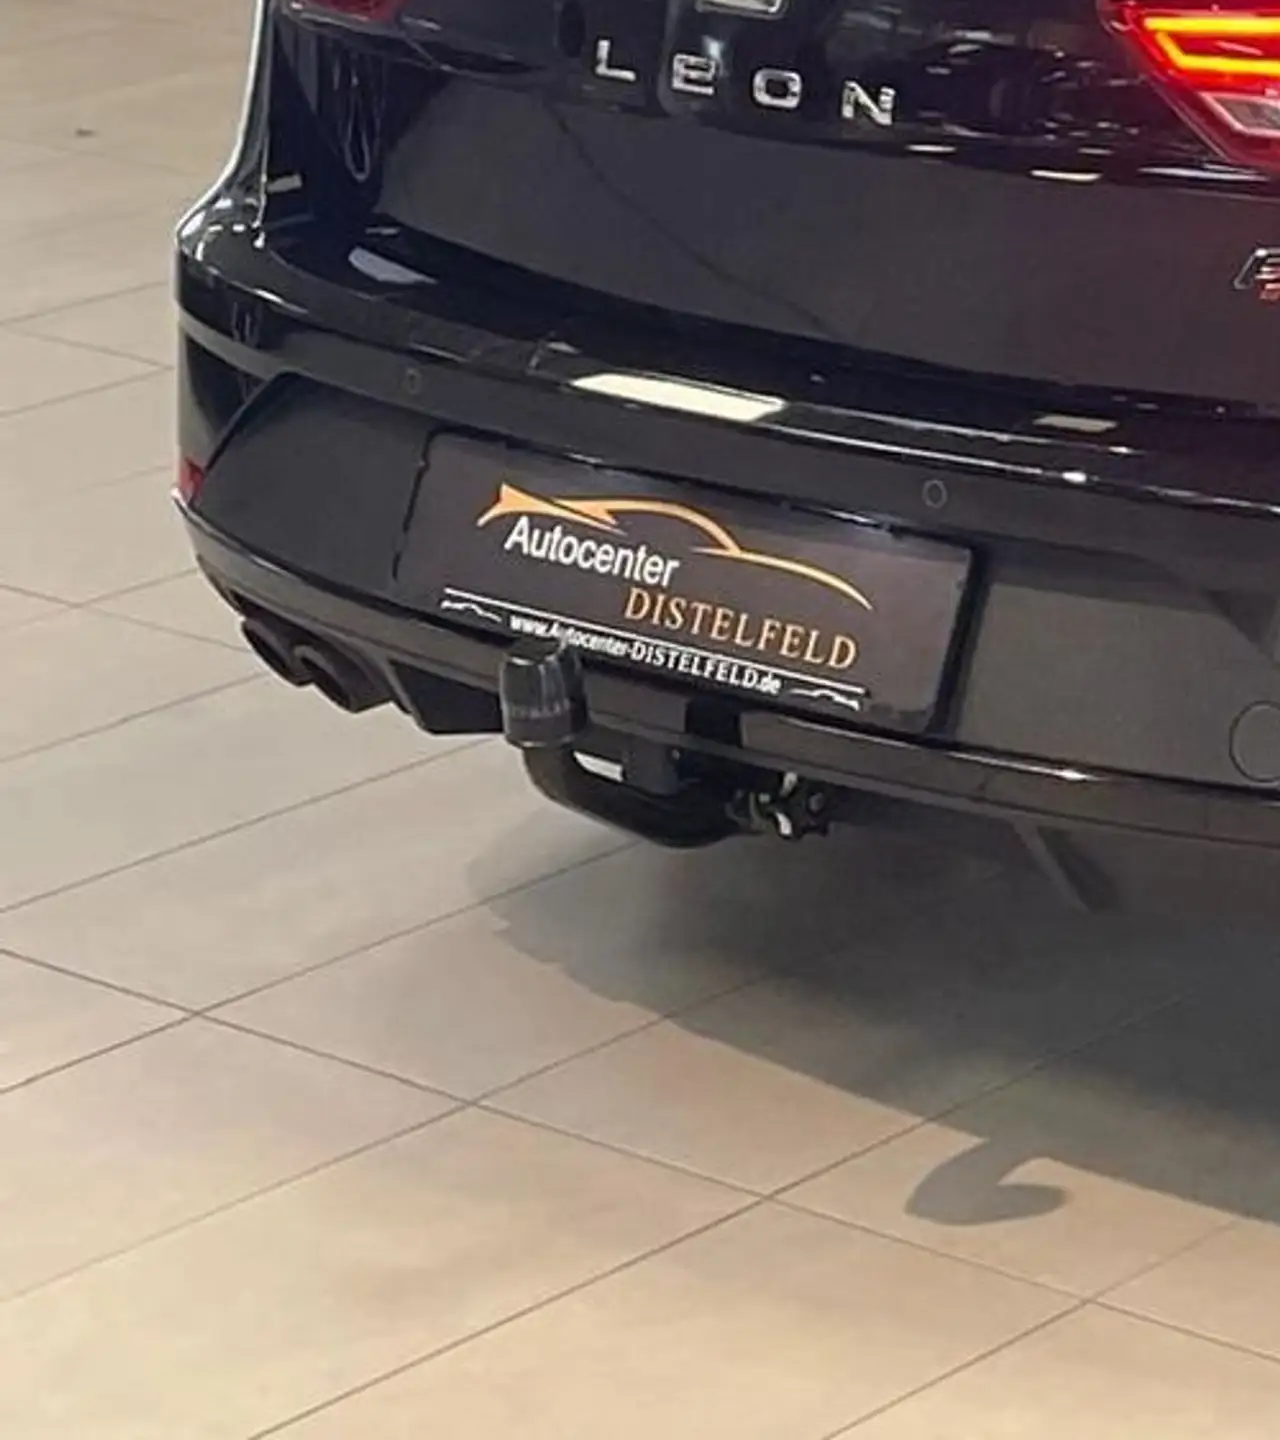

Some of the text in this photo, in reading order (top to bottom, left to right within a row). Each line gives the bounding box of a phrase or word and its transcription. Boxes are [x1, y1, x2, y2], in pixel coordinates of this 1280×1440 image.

[595, 39, 896, 126] LEON
[504, 515, 680, 588] Autocenter
[624, 587, 857, 670] DISTELFELD
